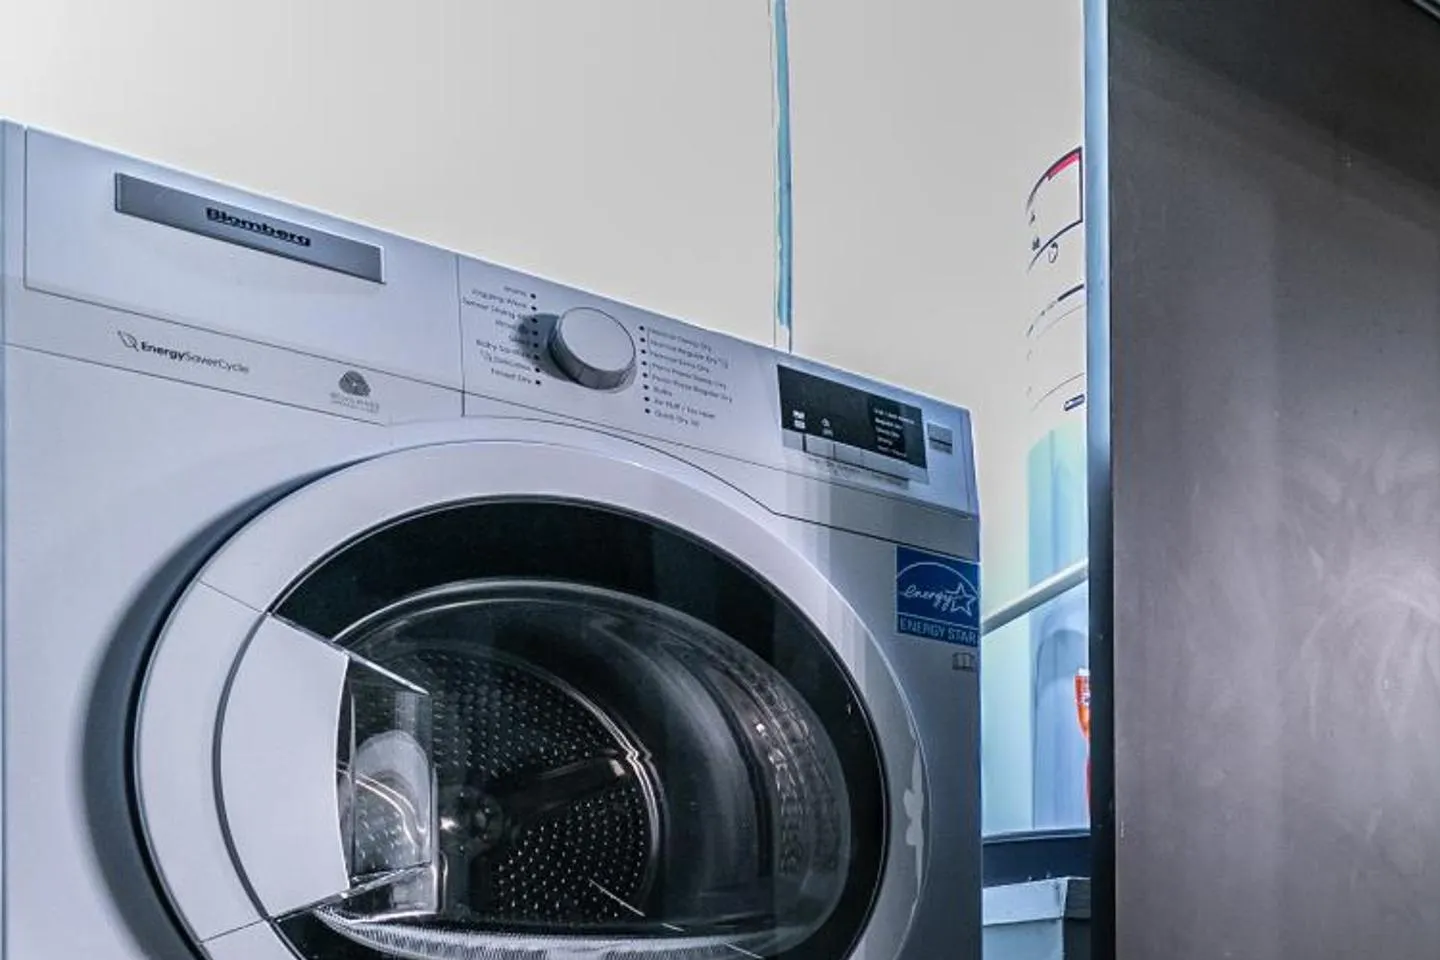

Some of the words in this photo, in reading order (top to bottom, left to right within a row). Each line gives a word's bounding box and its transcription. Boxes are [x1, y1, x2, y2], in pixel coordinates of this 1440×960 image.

[206, 207, 311, 247] Blomberg
[900, 619, 945, 639] ENERGY
[947, 627, 978, 646] STAR
